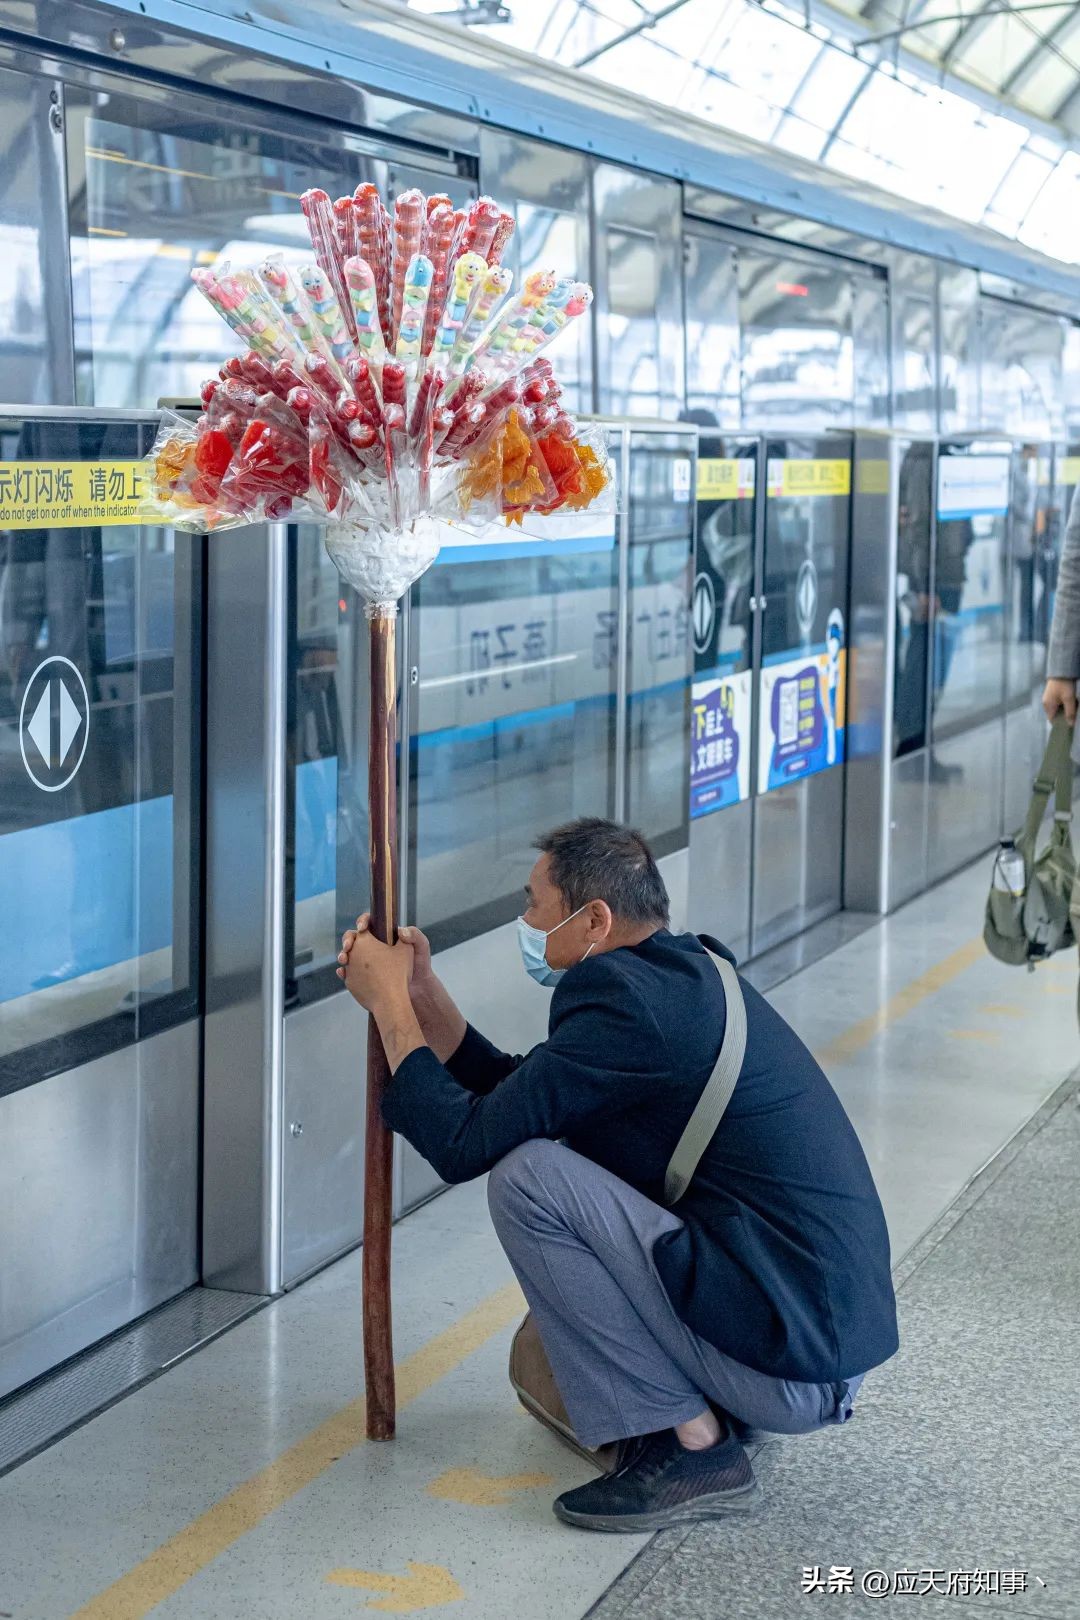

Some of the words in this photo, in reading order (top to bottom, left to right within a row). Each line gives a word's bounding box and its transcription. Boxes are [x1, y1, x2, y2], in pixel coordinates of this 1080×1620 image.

[0, 507, 10, 520] do
[12, 507, 25, 520] not
[26, 506, 39, 522] get
[40, 508, 50, 519] on
[51, 508, 60, 519] or
[61, 505, 72, 518] off
[73, 505, 93, 518] when
[93, 504, 106, 517] the
